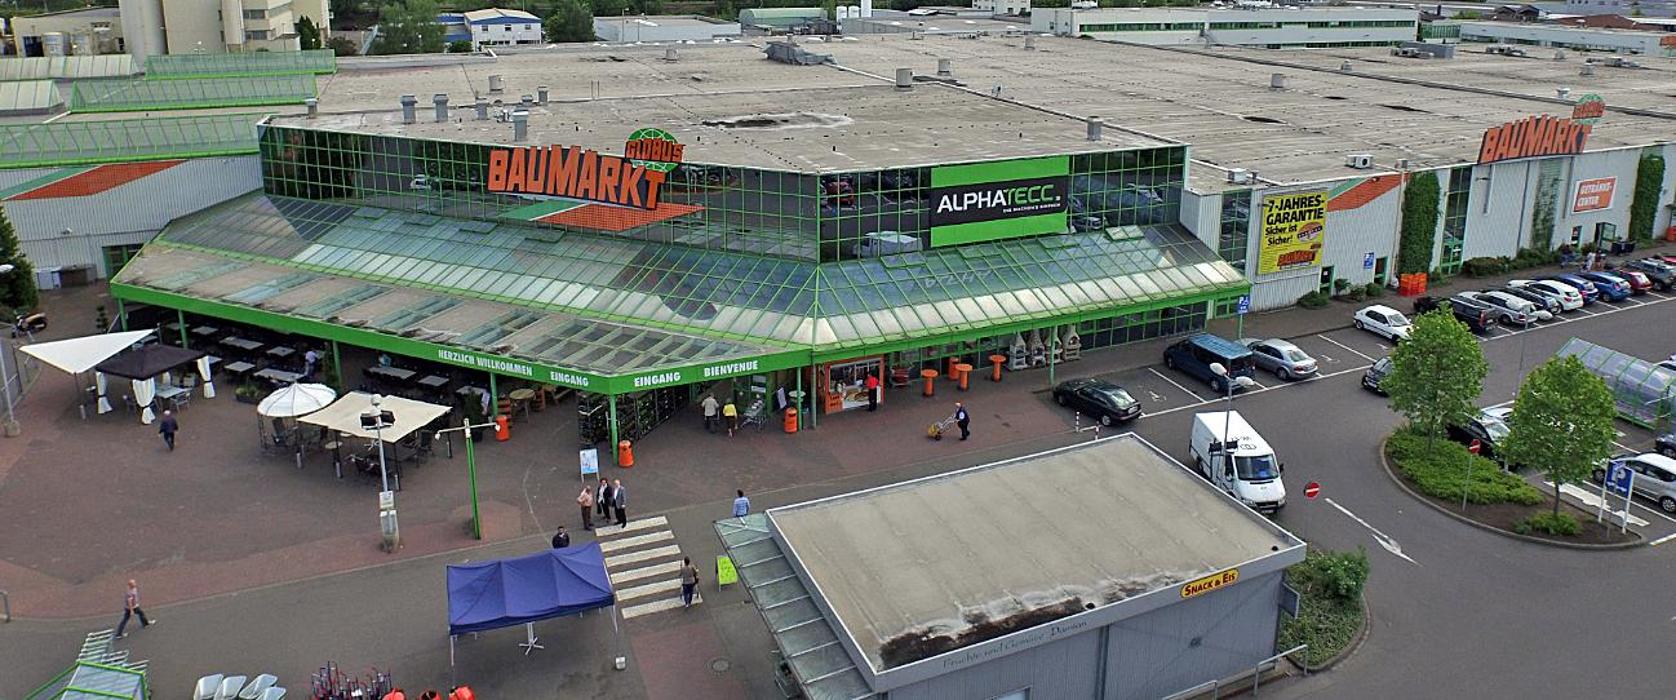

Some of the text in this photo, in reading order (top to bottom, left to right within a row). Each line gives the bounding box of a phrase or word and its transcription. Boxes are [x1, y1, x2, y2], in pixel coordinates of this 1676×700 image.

[626, 138, 684, 162] GLOBUS
[1480, 114, 1592, 163] BAUMARKT
[487, 144, 666, 210] BAUMARKT
[1268, 195, 1325, 212] 7-JAHRES-
[1266, 208, 1324, 225] GARANTIE
[1265, 225, 1287, 236] Sicher
[1288, 224, 1297, 232] ist
[438, 349, 589, 387] HERZLICH WILLKOMMEN EINGANG
[634, 360, 758, 387] EINGANG BIENVENUE
